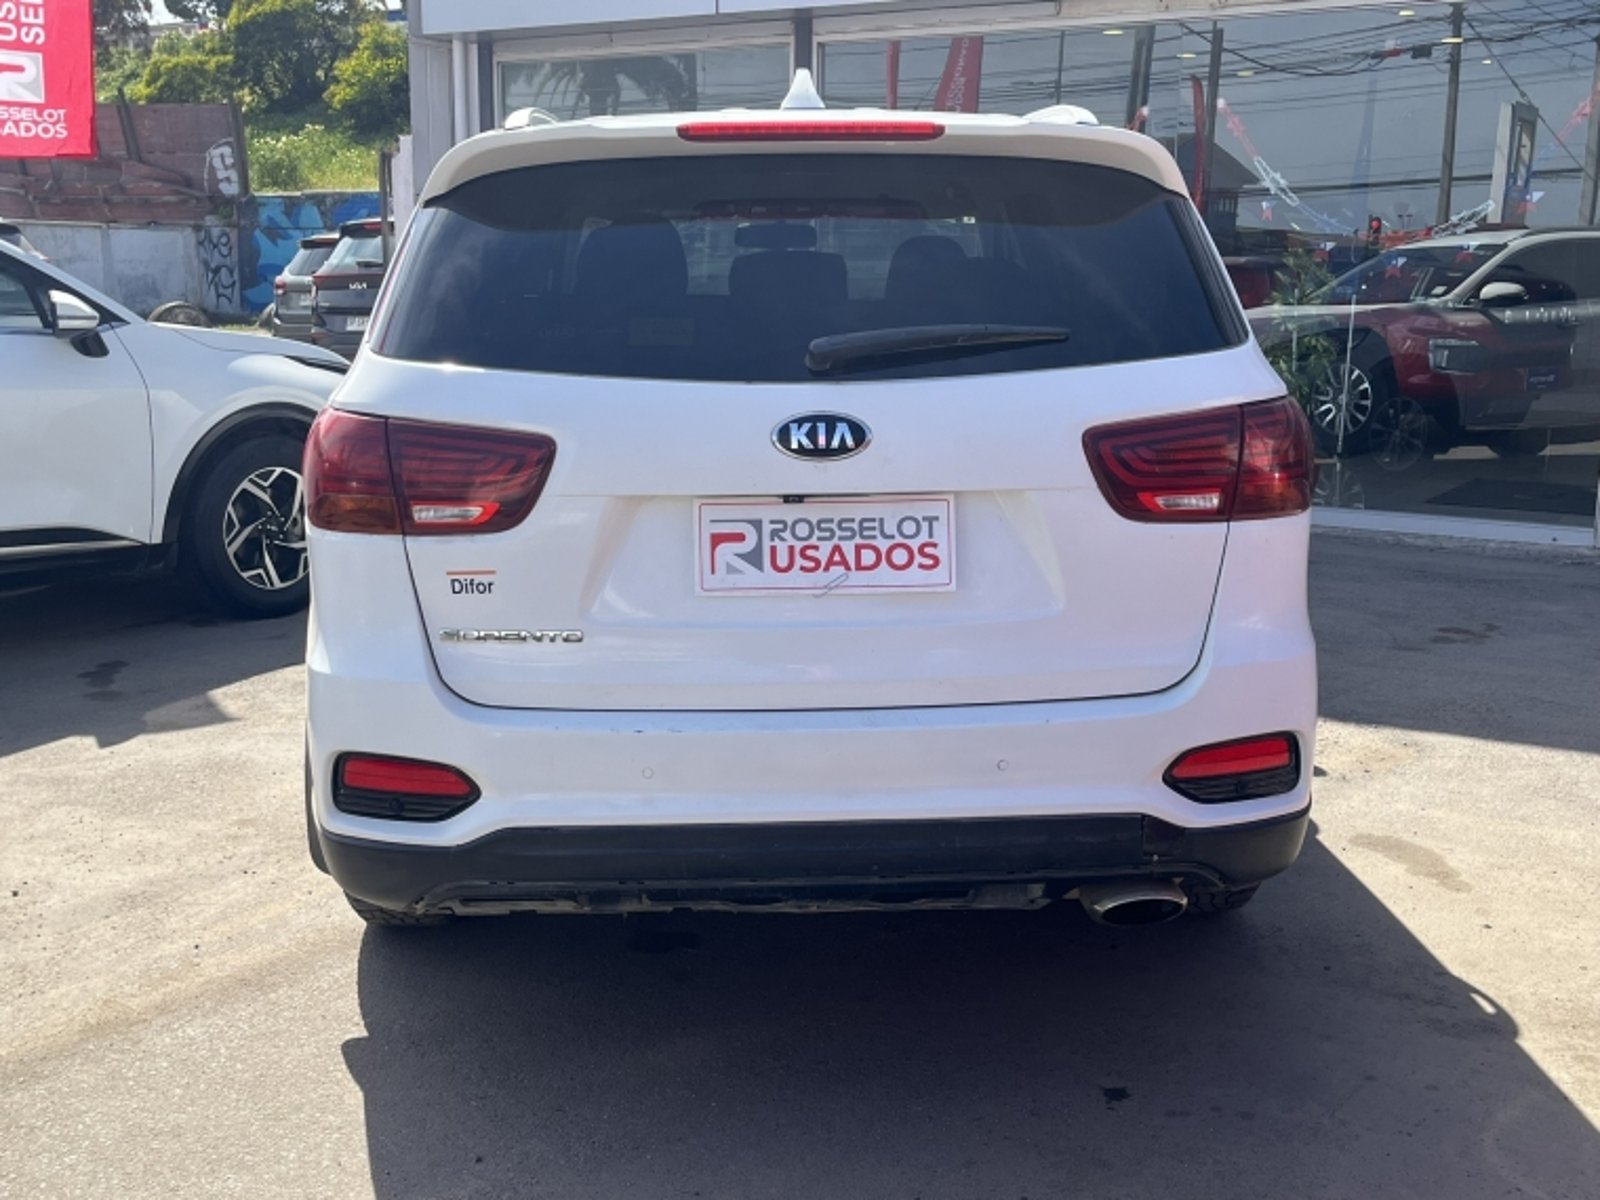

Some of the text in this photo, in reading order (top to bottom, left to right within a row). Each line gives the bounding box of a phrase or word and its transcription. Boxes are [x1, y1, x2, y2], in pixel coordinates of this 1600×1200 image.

[0, 0, 17, 41] US
[0, 106, 67, 122] SSELOT
[0, 121, 68, 138] ADOS
[789, 421, 856, 450] KIA
[769, 515, 940, 542] ROSSELOT
[769, 541, 942, 574] USADOS
[450, 578, 494, 595] Difor
[439, 628, 584, 643] SORENTO
